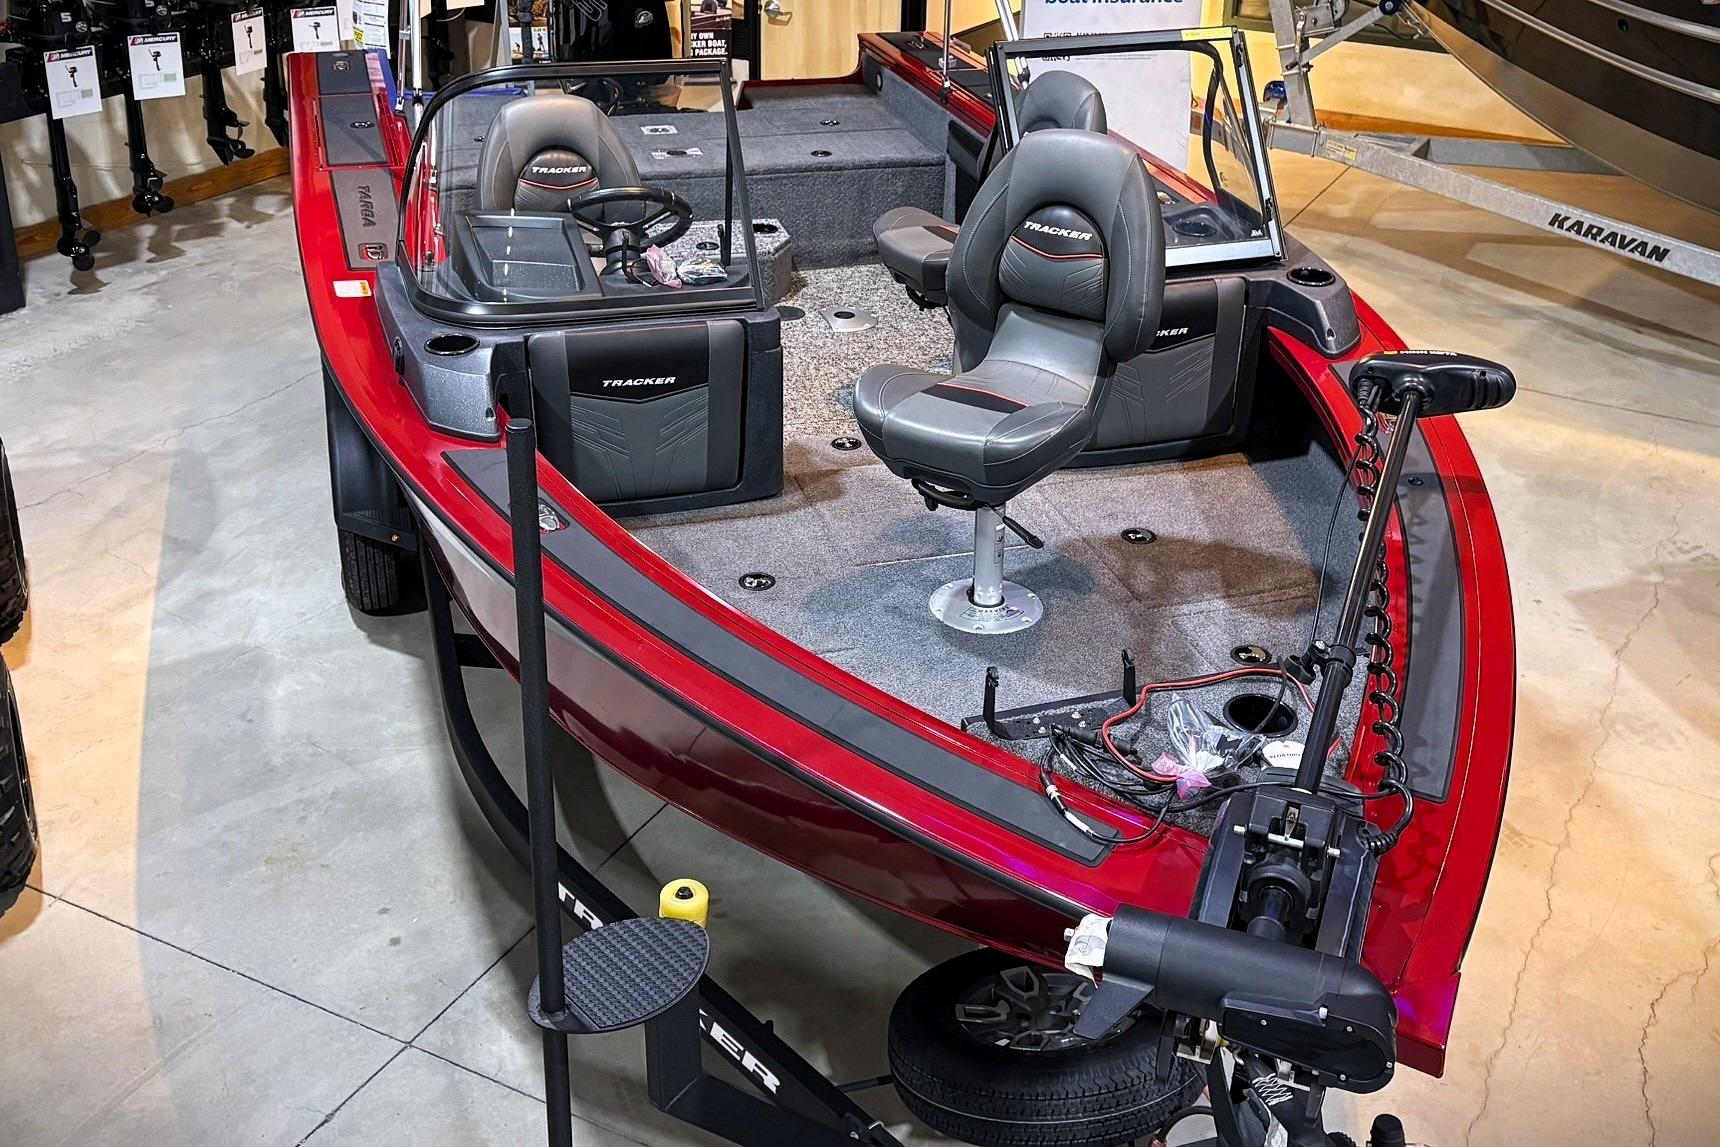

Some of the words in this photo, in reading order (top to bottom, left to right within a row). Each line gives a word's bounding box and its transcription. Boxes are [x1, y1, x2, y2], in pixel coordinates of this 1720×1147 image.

[60, 12, 72, 23] 5
[144, 35, 177, 43] MERCURY
[698, 32, 715, 40] OWN
[707, 39, 728, 48] BOAT,
[694, 47, 729, 57] PACKAGE.
[531, 166, 587, 174] TRACKER
[1023, 221, 1093, 241] TRACKER
[1548, 212, 1671, 263] KARAVAN
[602, 376, 677, 388] TRACKER
